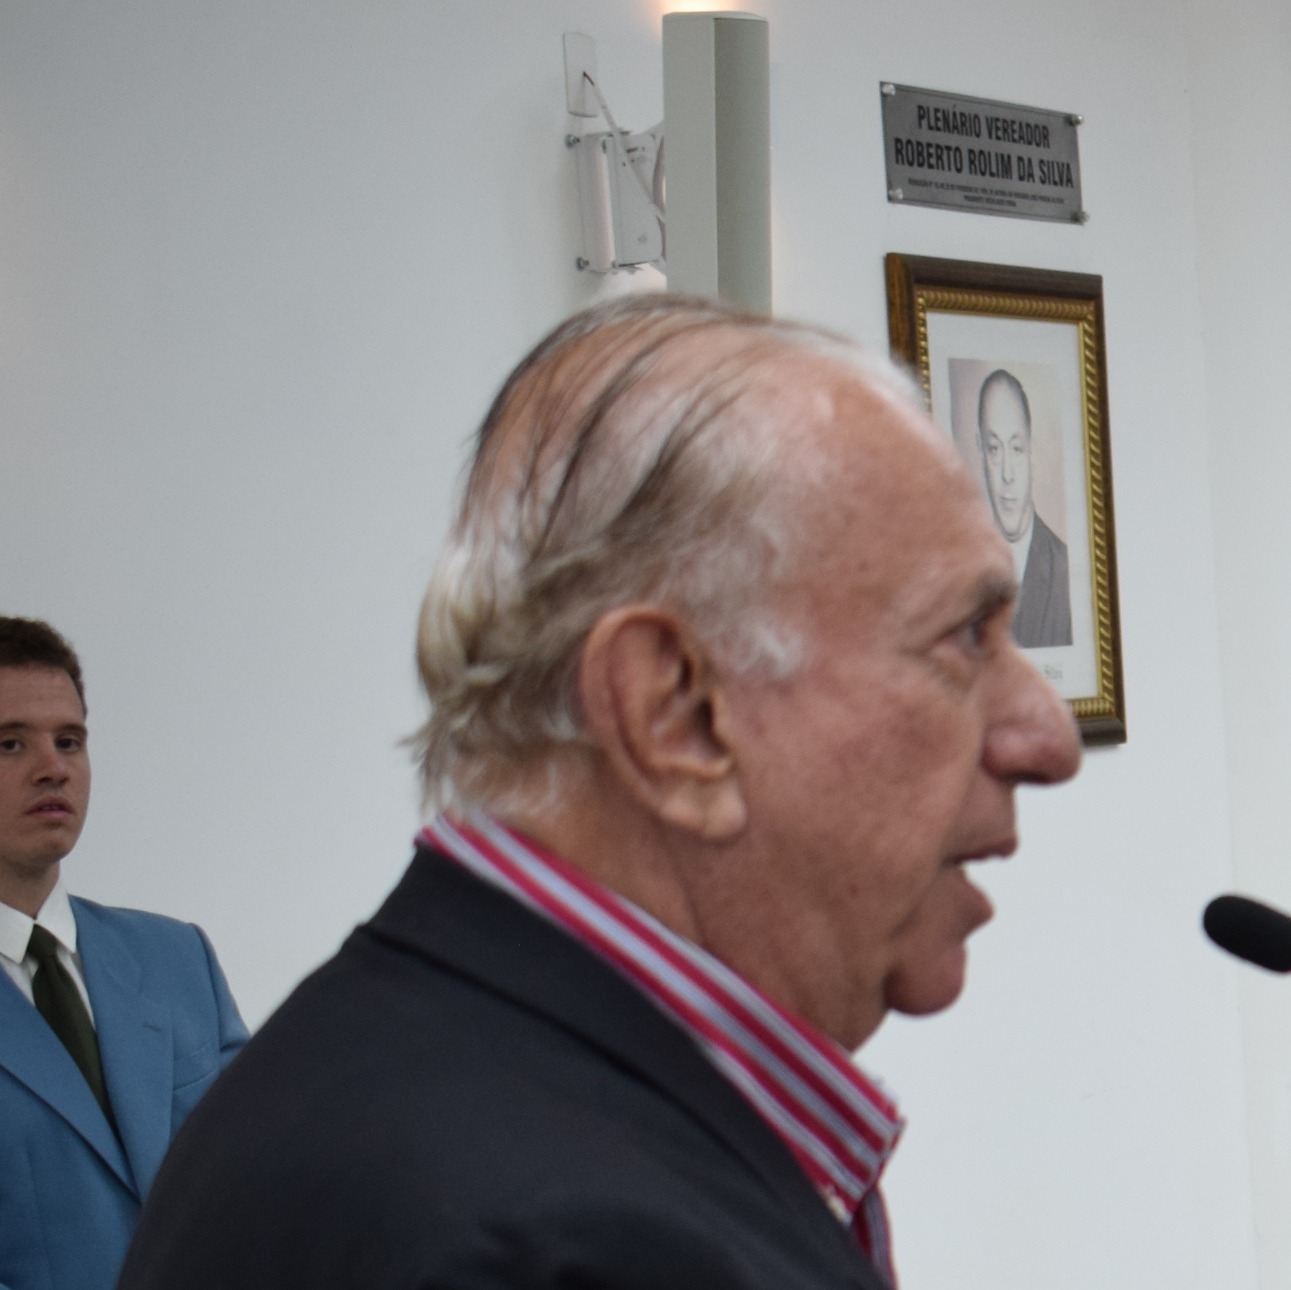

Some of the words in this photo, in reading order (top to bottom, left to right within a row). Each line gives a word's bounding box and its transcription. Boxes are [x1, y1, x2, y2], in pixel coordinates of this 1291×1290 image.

[917, 104, 982, 138] PLENÁRIO
[985, 115, 1051, 149] VEREADOR
[894, 137, 963, 174] ROBERTO
[968, 148, 1013, 180] ROLIM
[1017, 156, 1035, 183] DA
[1039, 159, 1075, 189] SILVA
